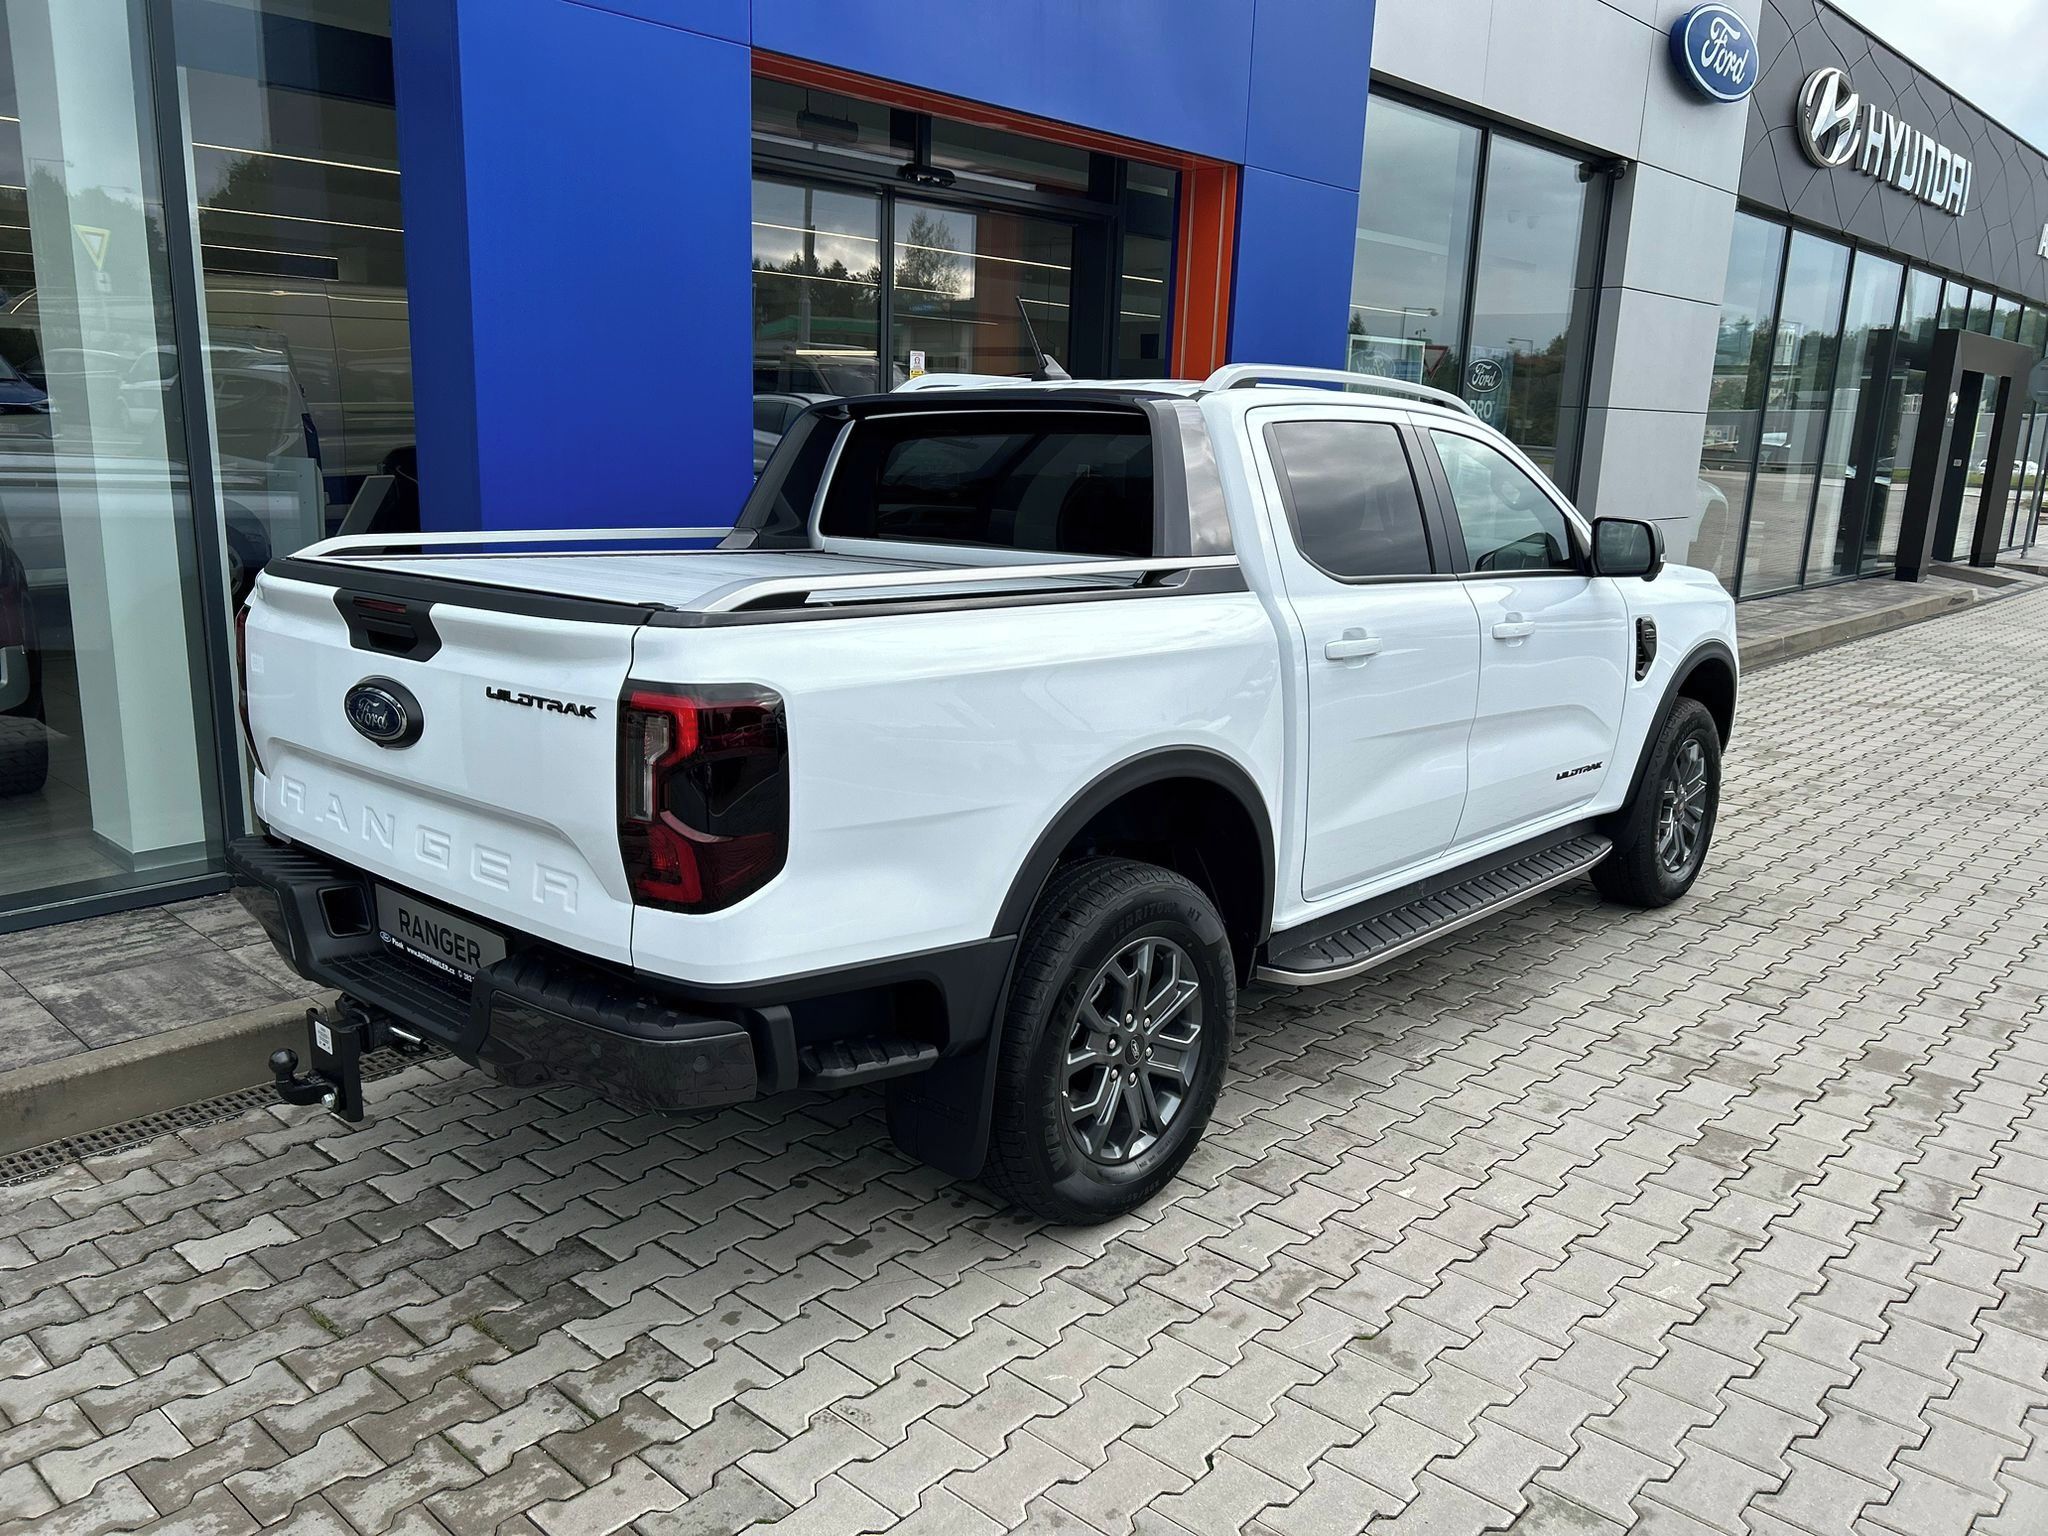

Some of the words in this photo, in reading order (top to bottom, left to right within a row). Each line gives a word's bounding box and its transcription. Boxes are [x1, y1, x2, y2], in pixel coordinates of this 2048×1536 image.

[1701, 16, 1750, 85] Ford
[1856, 103, 1973, 217] HYUNDAI
[1471, 363, 1496, 388] Ford
[355, 697, 389, 731] Ford
[485, 686, 599, 719] WILDTRAK
[1556, 761, 1603, 781] WILDTRAK
[280, 774, 581, 915] RANGER
[398, 907, 482, 968] RANGER
